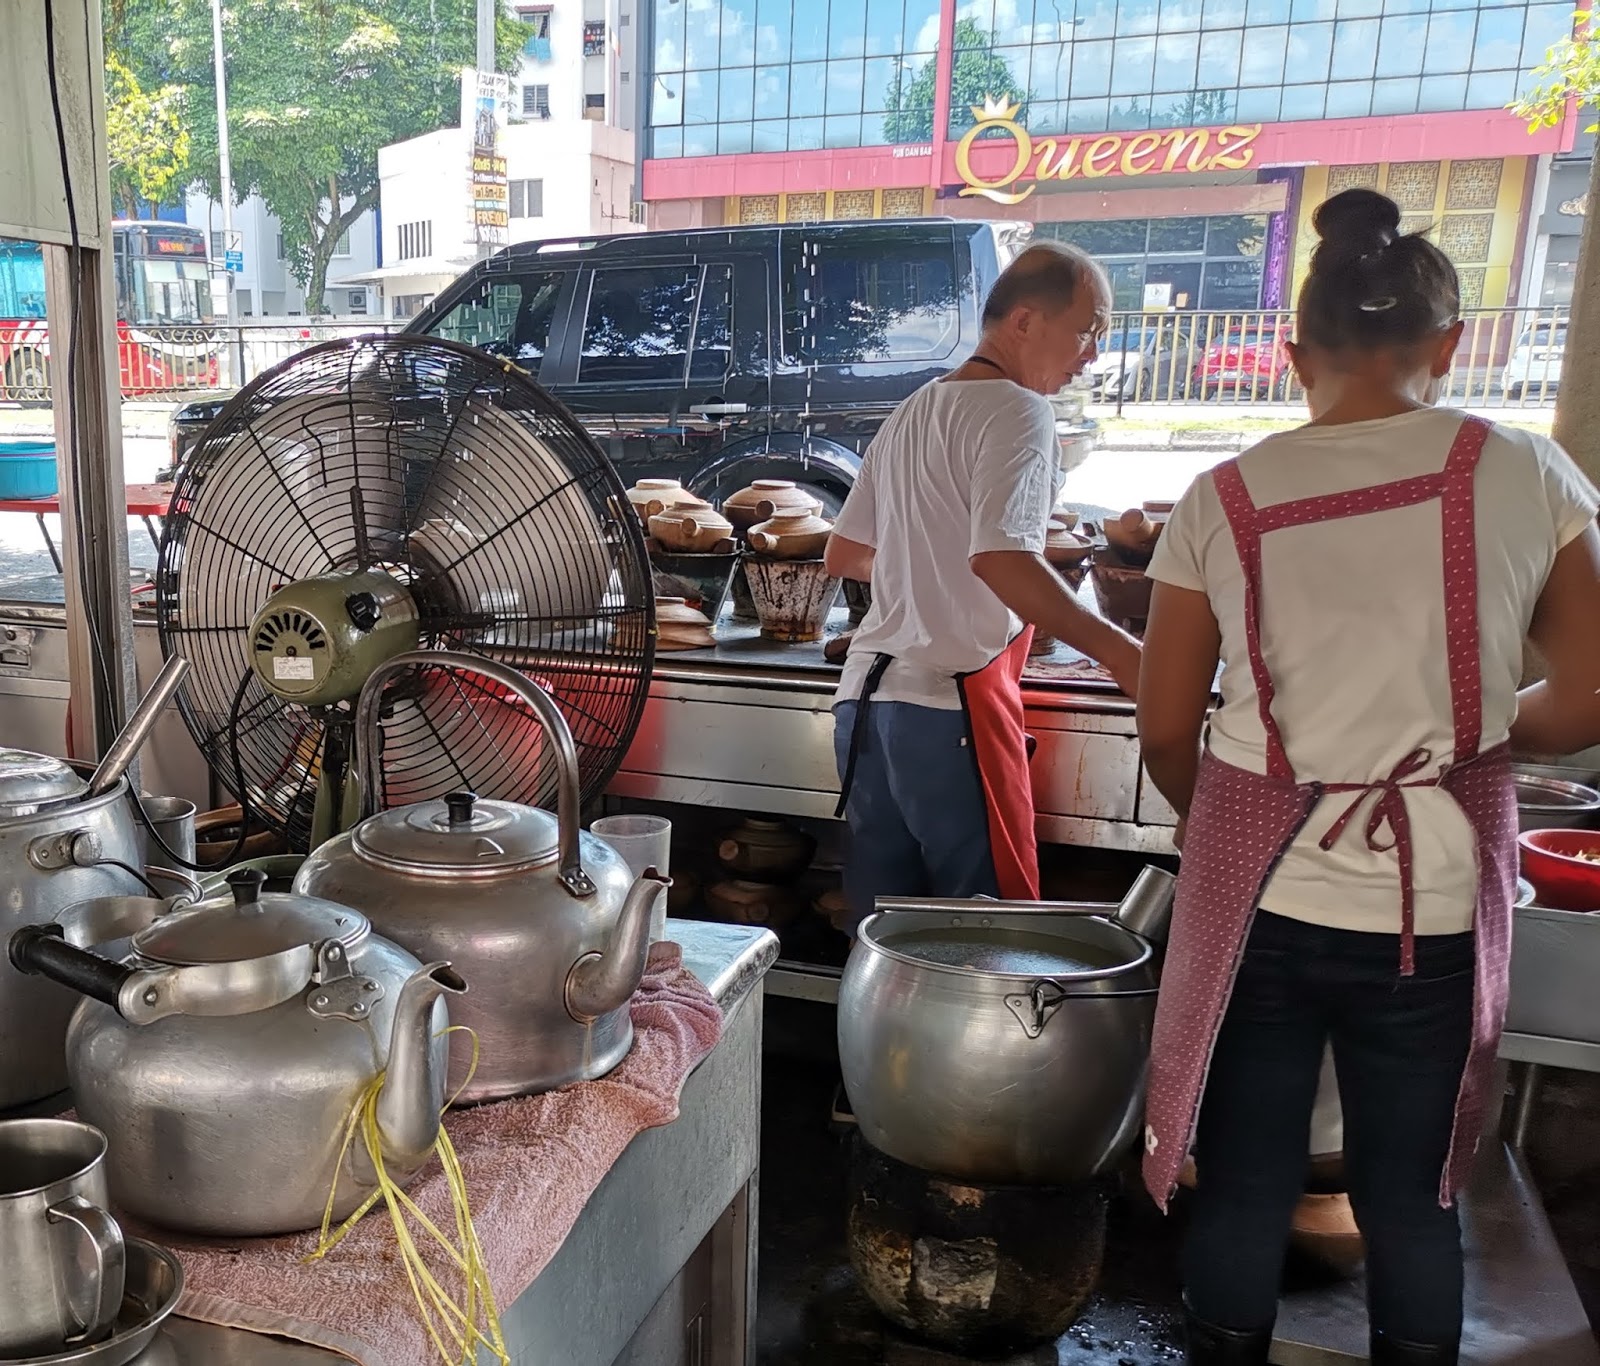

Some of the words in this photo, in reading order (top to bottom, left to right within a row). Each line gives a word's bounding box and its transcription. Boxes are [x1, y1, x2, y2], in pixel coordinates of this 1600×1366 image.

[893, 148, 904, 158] PUB
[905, 147, 919, 157] DAN
[920, 146, 932, 156] BAR
[955, 119, 1262, 205] Queenz
